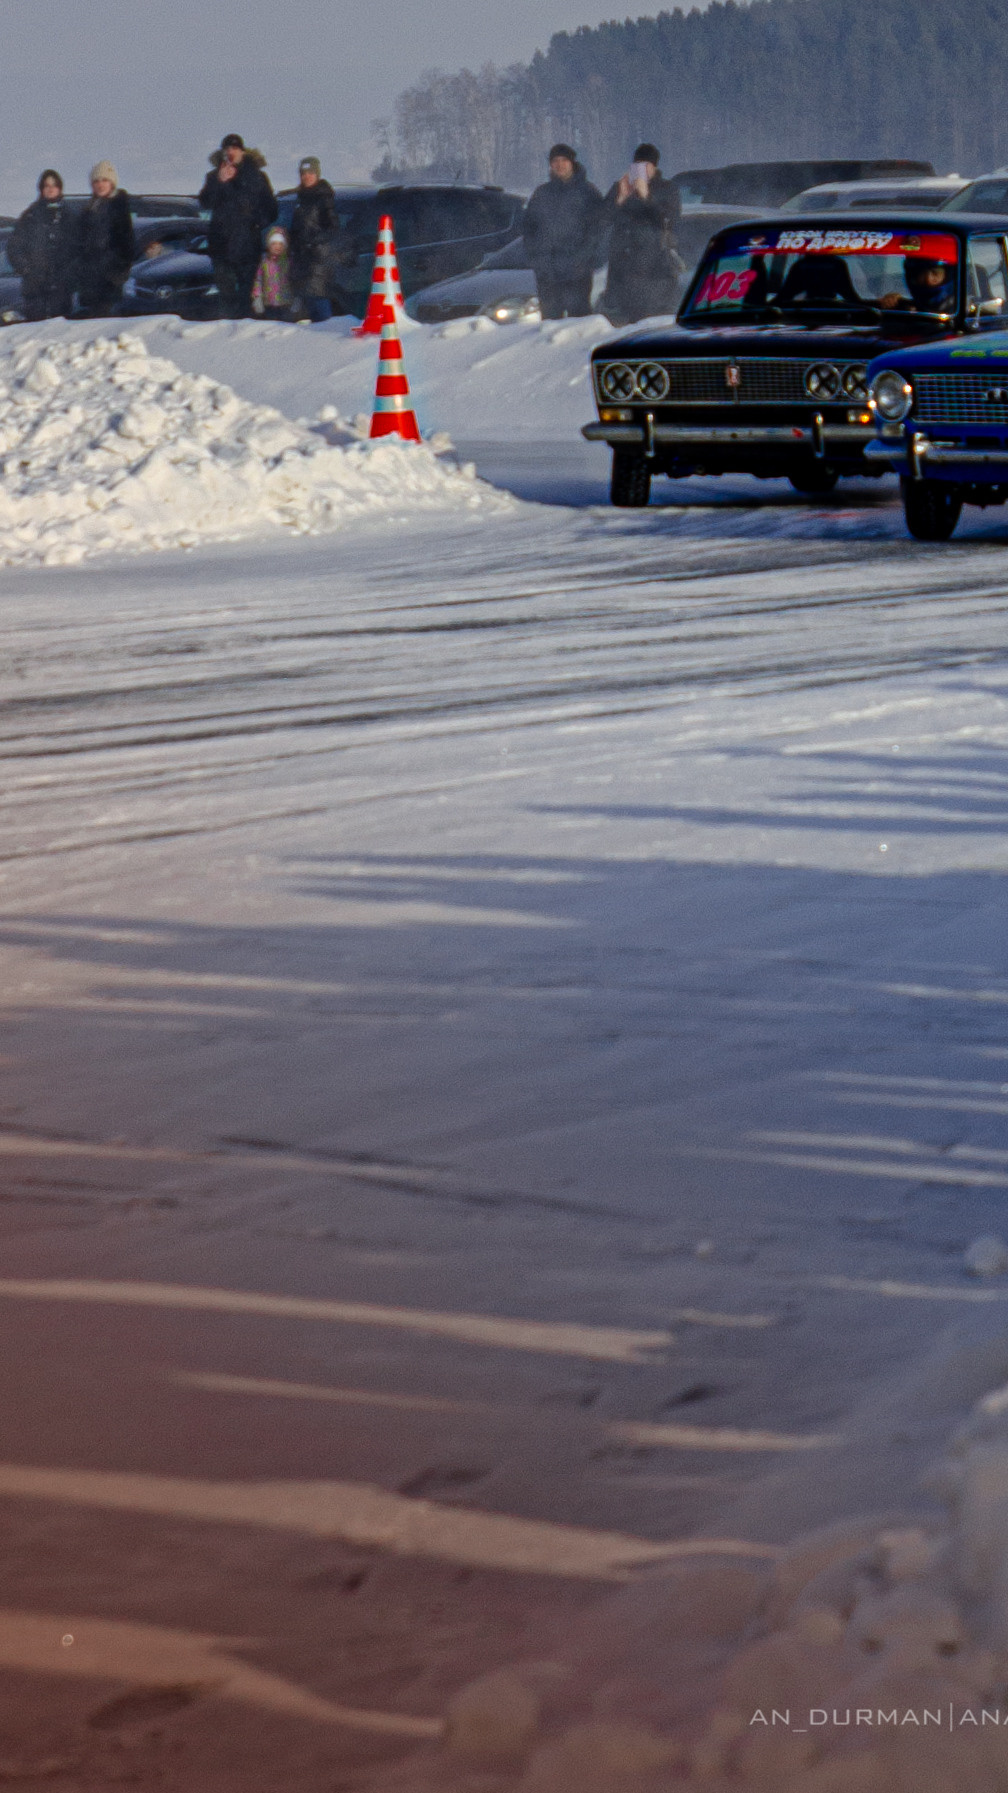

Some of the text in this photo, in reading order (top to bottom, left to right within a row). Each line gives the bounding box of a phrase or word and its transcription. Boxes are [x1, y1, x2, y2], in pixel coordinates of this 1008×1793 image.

[776, 238, 804, 250] ПО
[805, 238, 892, 251] ДРИФТУ
[694, 268, 757, 304] 103
